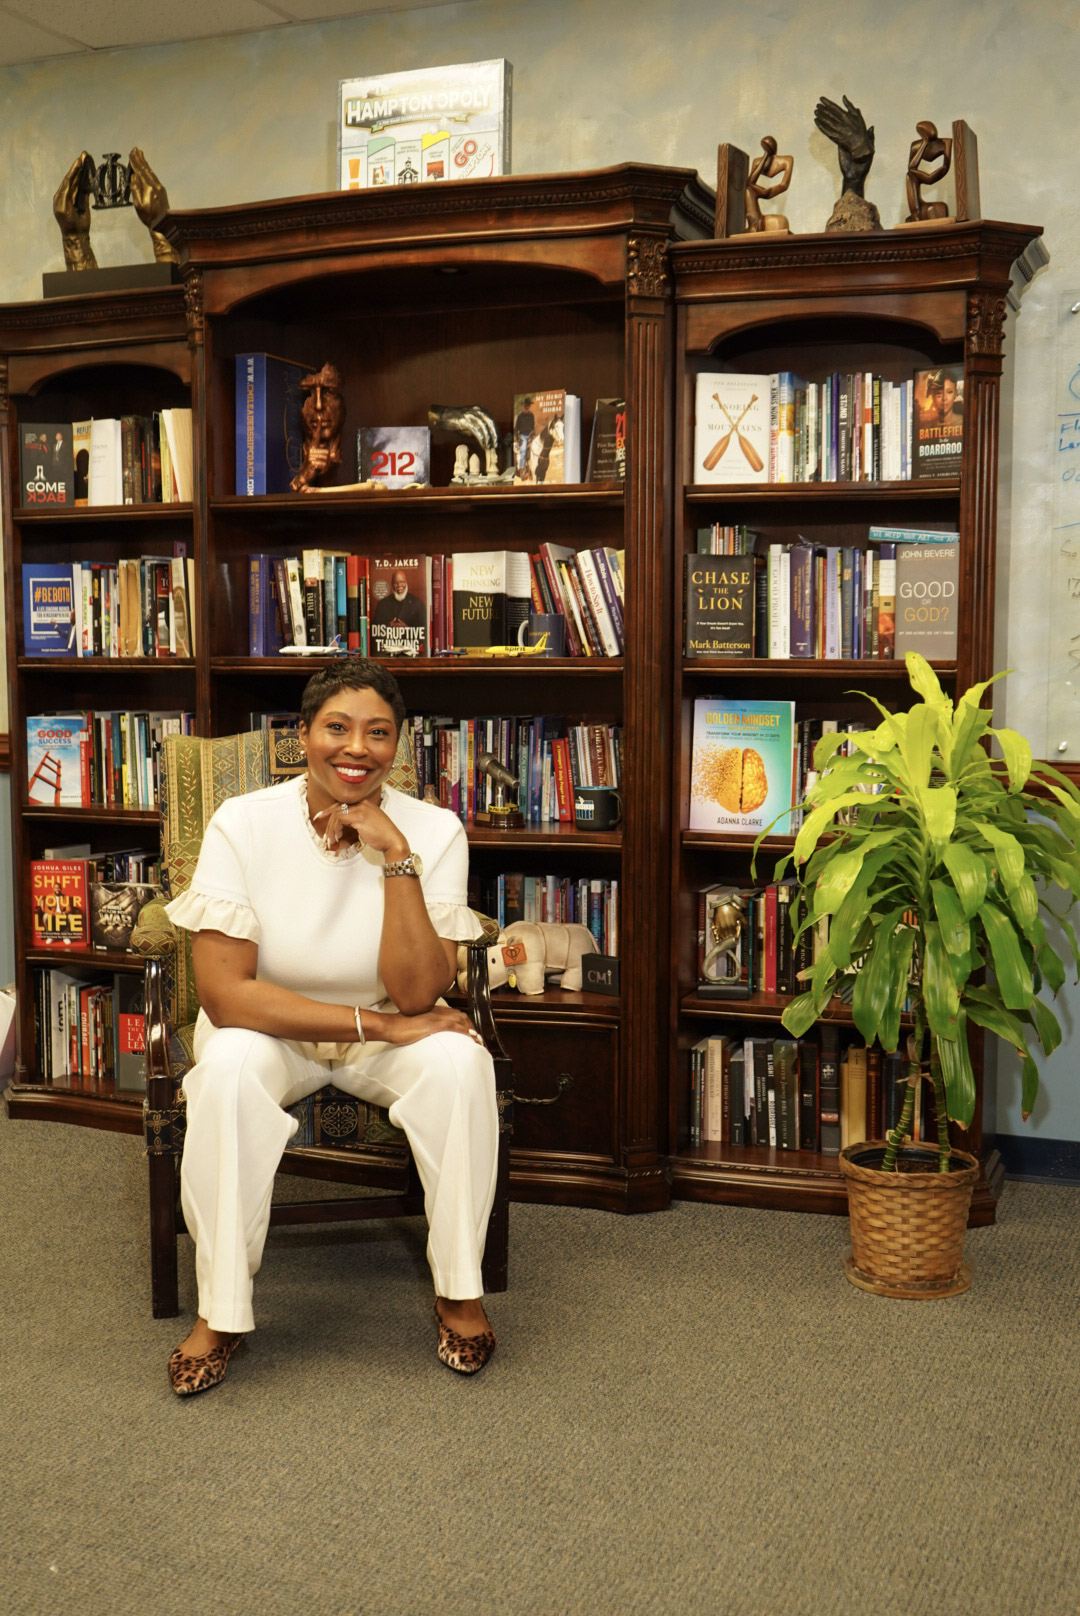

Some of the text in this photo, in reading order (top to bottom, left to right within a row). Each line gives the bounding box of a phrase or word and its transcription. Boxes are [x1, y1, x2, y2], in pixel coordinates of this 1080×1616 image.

[454, 139, 478, 168] GO
[920, 425, 963, 440] BATTLEFIEL
[919, 442, 962, 458] BOARDROO
[26, 482, 66, 492] COME
[901, 549, 955, 559] JOHN BEVERE
[470, 565, 495, 577] NEW
[585, 569, 593, 586] How
[599, 563, 607, 579] Bible
[691, 571, 750, 585] CHASE
[462, 578, 500, 588] THINKING
[900, 581, 954, 598] GOOD
[34, 586, 70, 603] #BEBOTH
[588, 587, 595, 595] to
[469, 596, 494, 608] NEW
[589, 595, 599, 608] Say
[699, 596, 743, 610] LION
[904, 607, 949, 622] GOD?
[372, 624, 425, 639] DISRUPTIVE
[689, 640, 750, 648] Mark Batterson
[706, 712, 780, 728] GOLDEN MINDSET
[38, 730, 72, 738] GOOD
[596, 745, 604, 775] PICTURE
[717, 817, 763, 827] ADANNA CLARKE
[34, 875, 81, 888] SHIFT
[34, 896, 82, 907] YOUR
[34, 914, 83, 931] LIFE
[99, 913, 132, 928] WAR
[128, 1032, 144, 1041] LA
[128, 1041, 145, 1049] LEA
